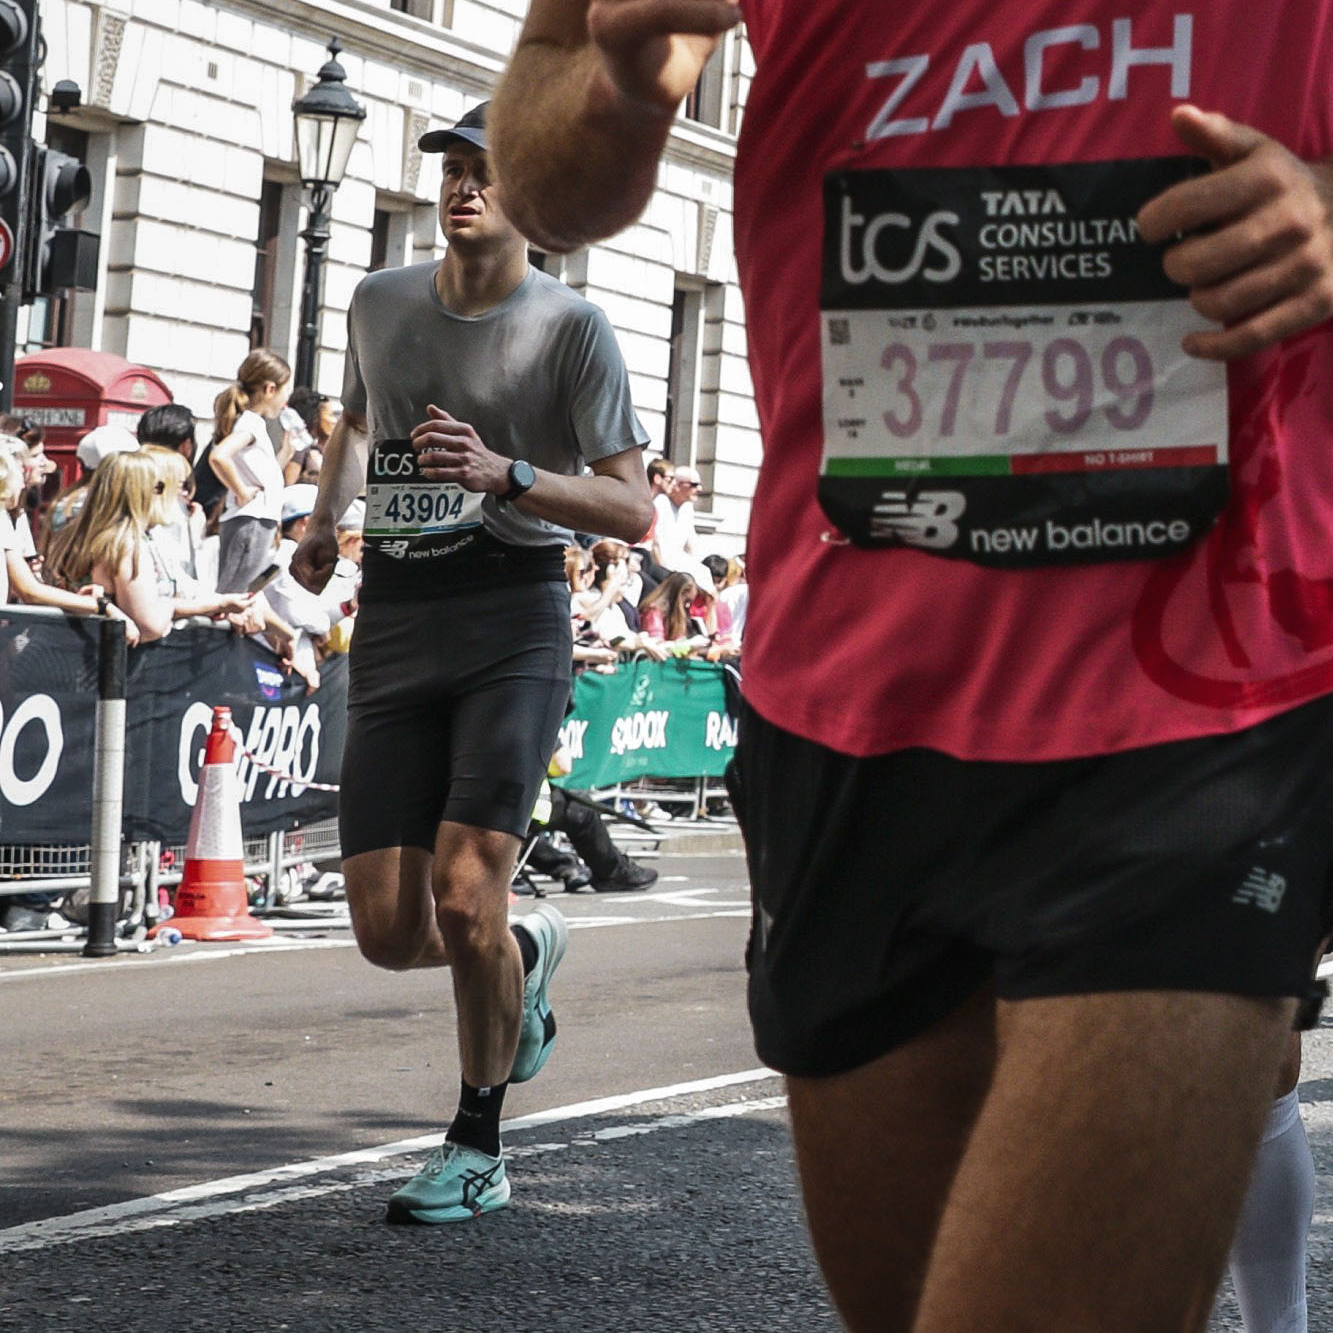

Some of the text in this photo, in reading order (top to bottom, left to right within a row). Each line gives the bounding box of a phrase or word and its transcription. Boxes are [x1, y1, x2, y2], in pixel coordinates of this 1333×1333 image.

[865, 14, 1194, 142] ZACH
[981, 190, 1066, 216] TATA
[840, 195, 962, 284] tcs
[979, 219, 1138, 249] CONSULTAN
[979, 253, 1112, 282] SERVICES
[880, 336, 1154, 438] 37799
[374, 447, 414, 476] tcs
[1086, 453, 1106, 465] NO
[385, 492, 465, 523] 43904
[408, 534, 474, 560] new balance
[970, 519, 1190, 553] new balance
